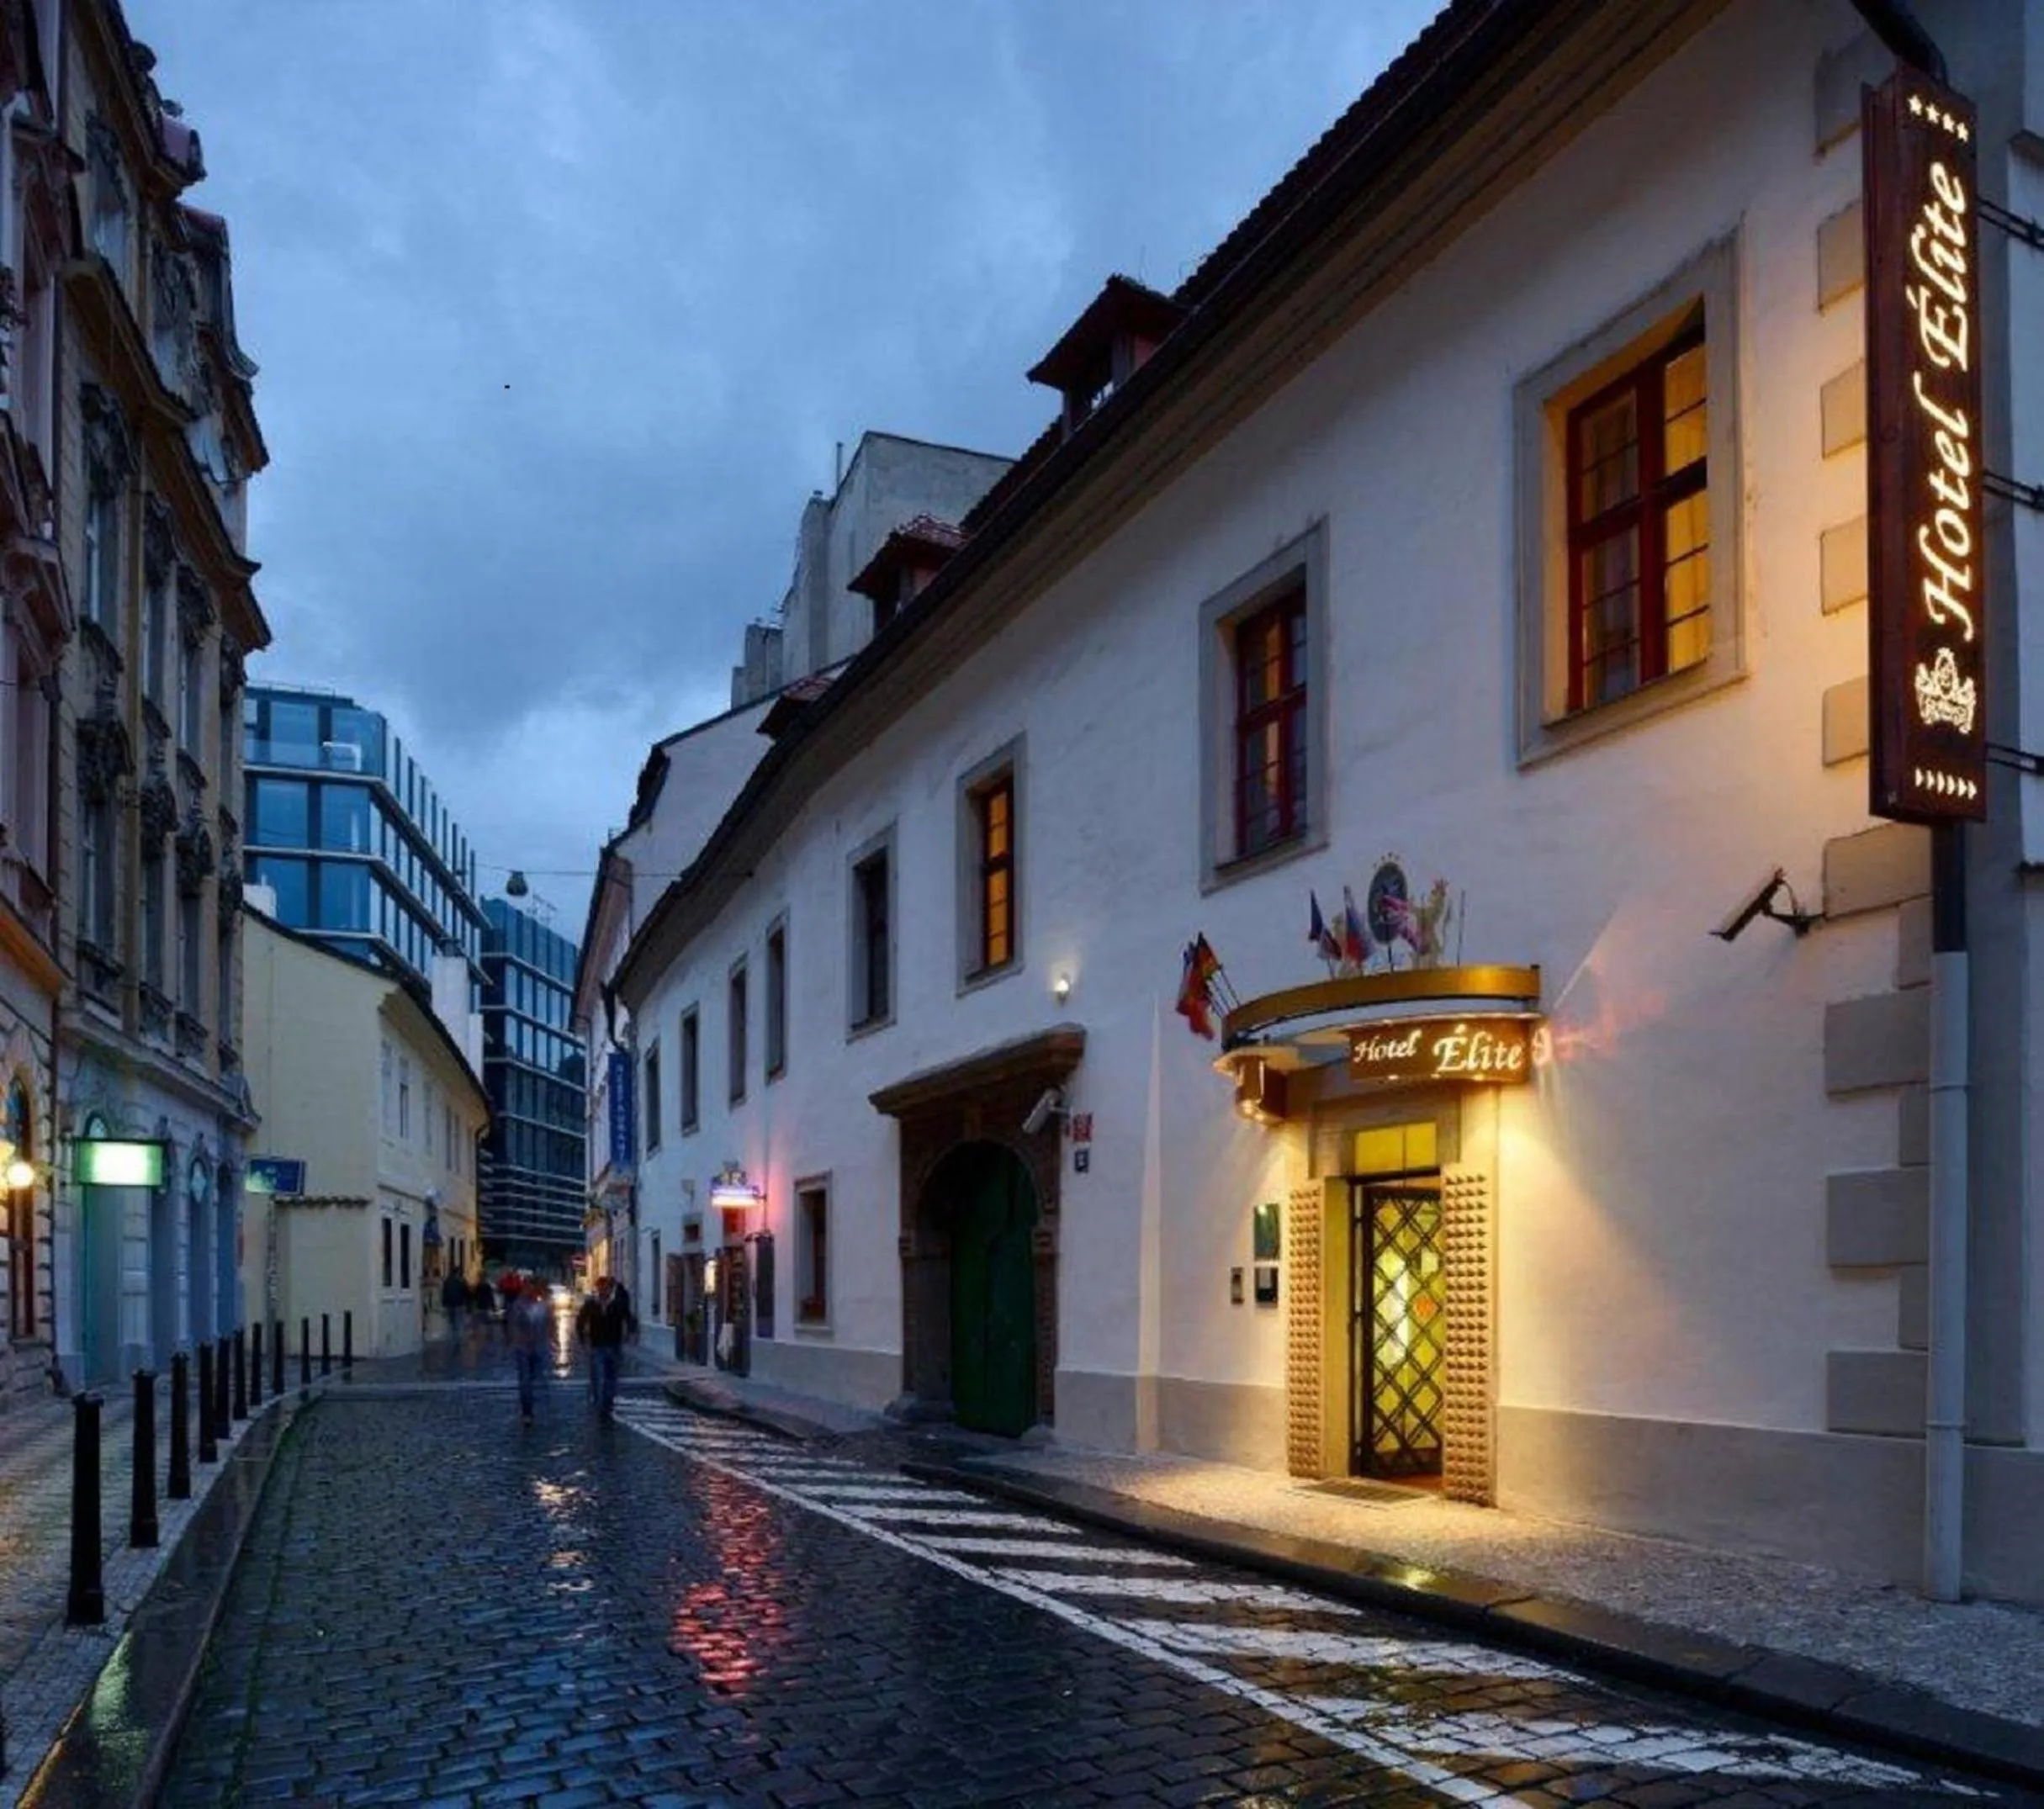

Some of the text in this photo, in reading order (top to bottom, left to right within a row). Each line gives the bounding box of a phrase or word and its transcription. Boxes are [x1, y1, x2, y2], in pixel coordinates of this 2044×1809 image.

[1906, 161, 1974, 643] Hotel Élite
[1353, 1024, 1523, 1072] Hotel Élite
